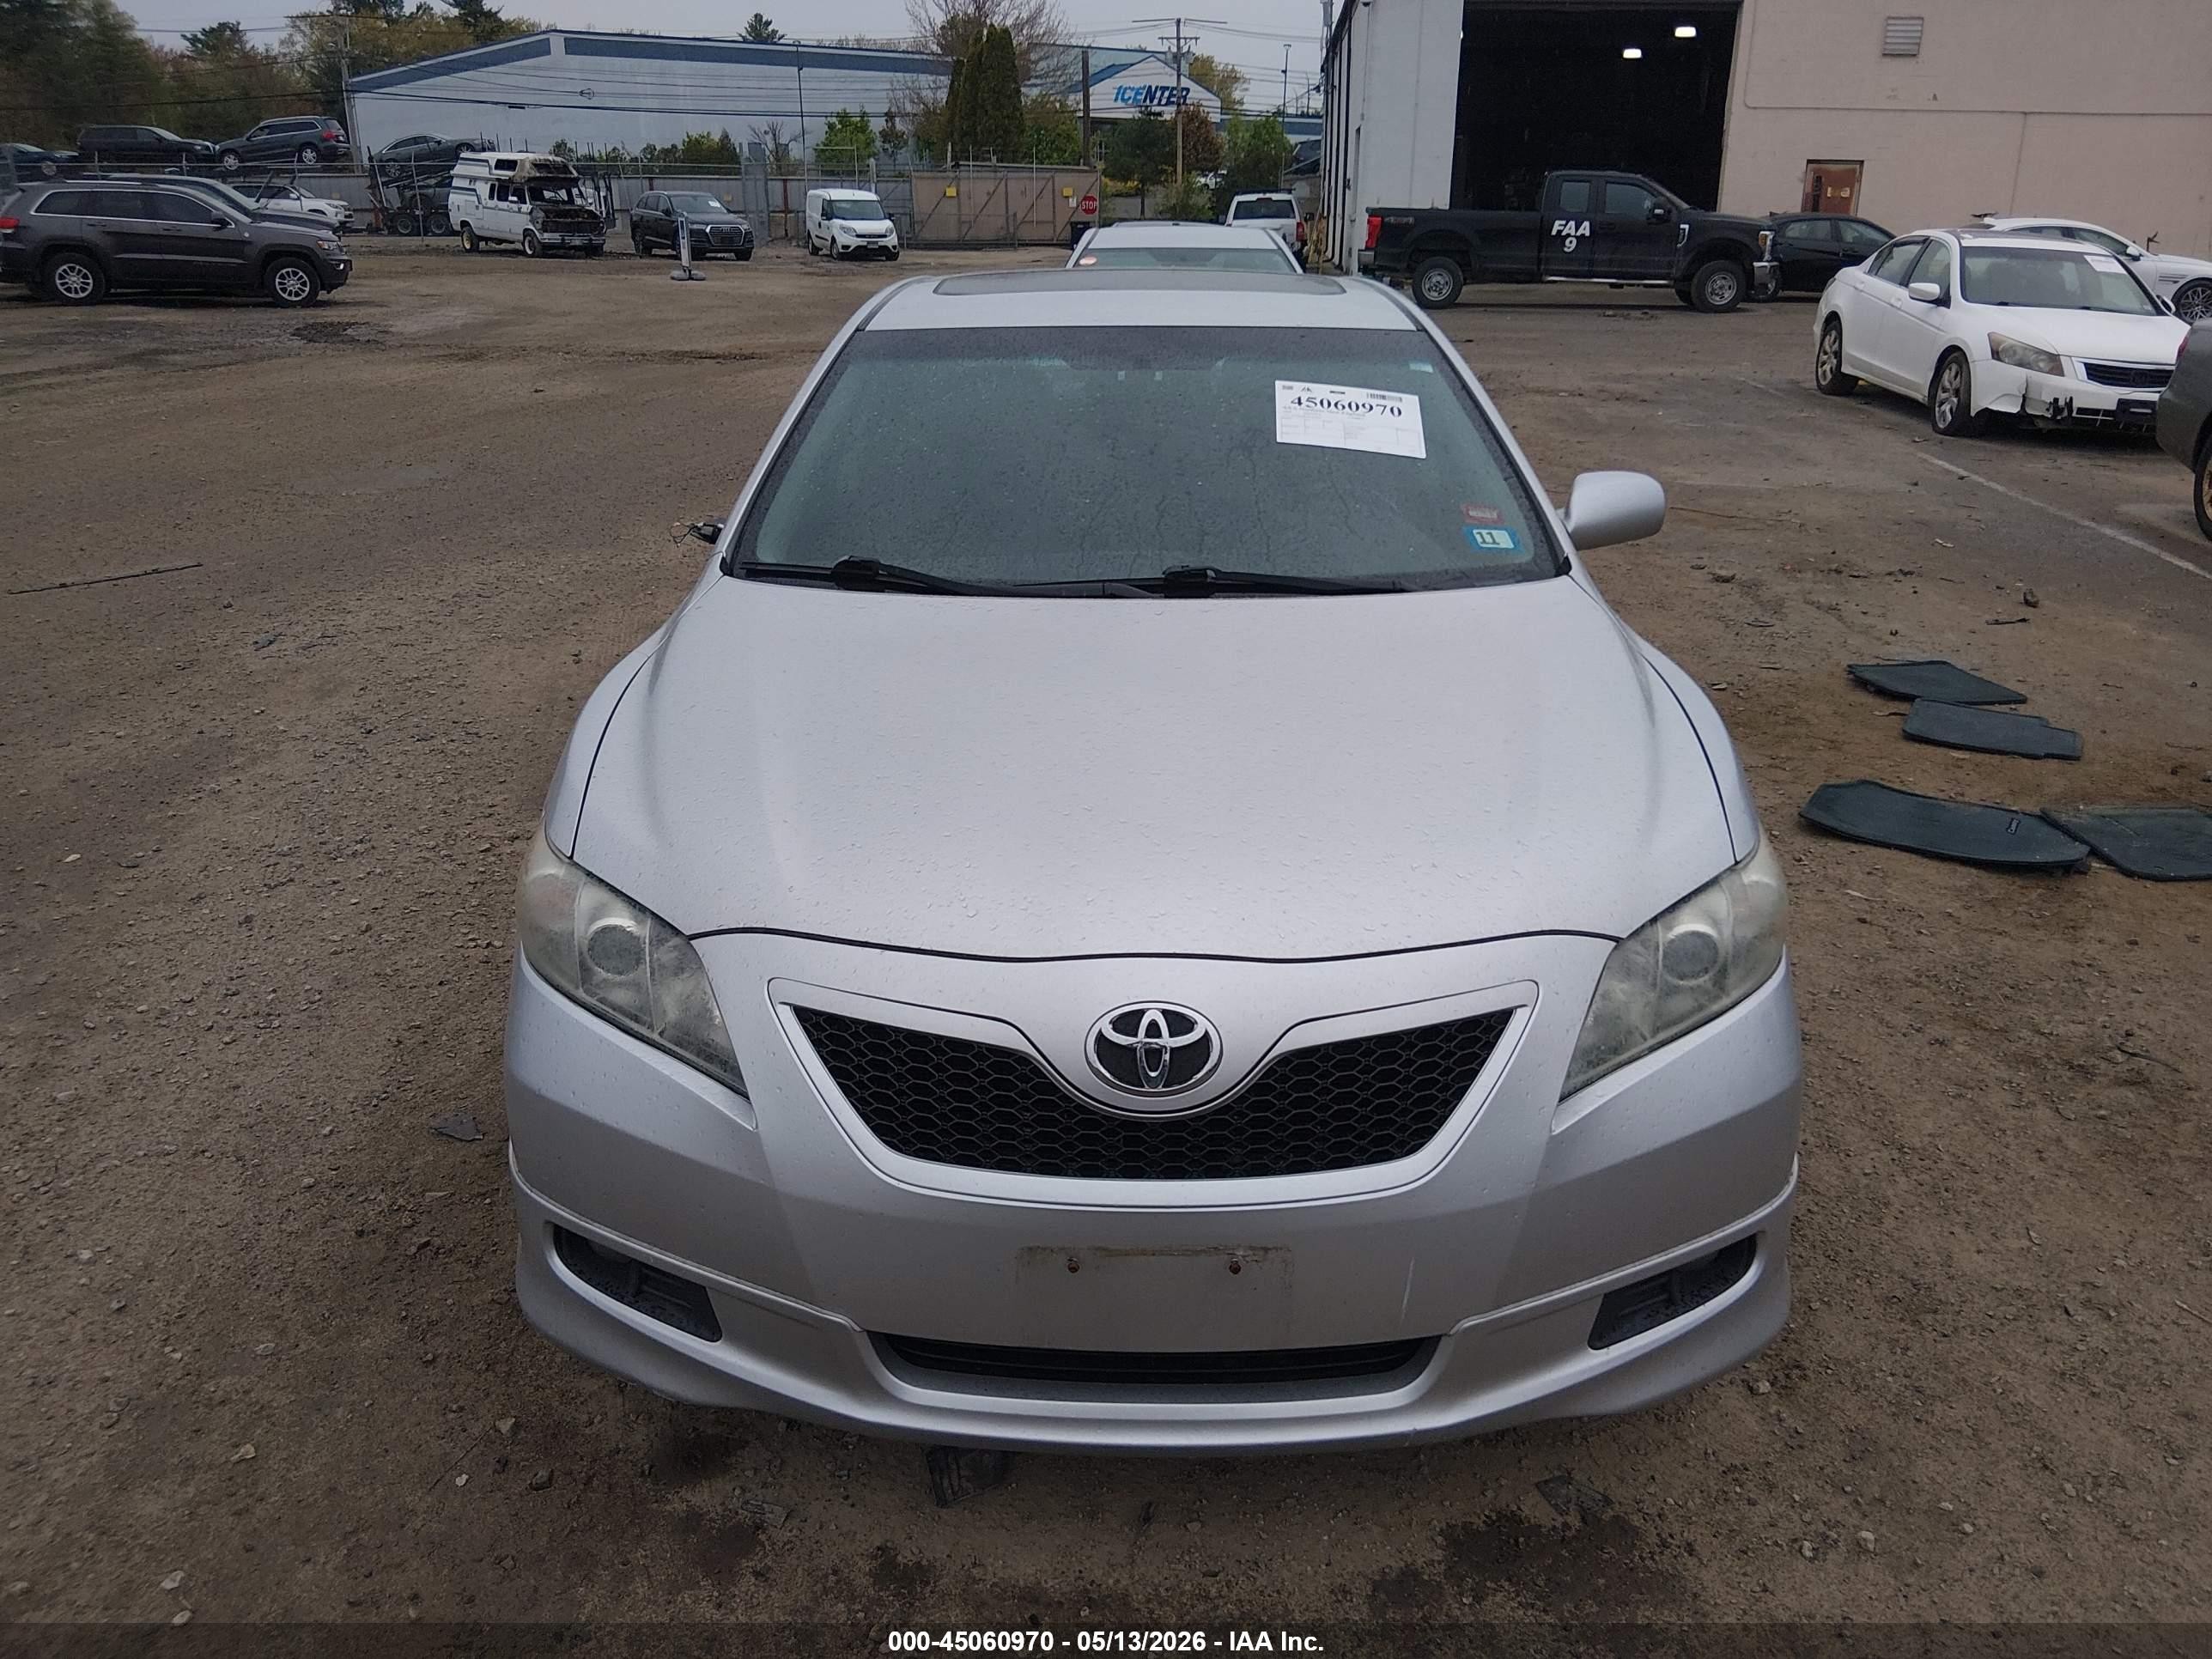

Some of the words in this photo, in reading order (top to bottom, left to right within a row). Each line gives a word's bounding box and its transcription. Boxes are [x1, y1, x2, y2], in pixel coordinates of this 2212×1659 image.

[1114, 84, 1190, 105] ICENTER
[1081, 200, 1097, 210] STOP
[1551, 220, 1590, 236] FAA
[1564, 236, 1577, 252] 9
[1291, 395, 1402, 418] 45060970
[1475, 532, 1501, 546] 11
